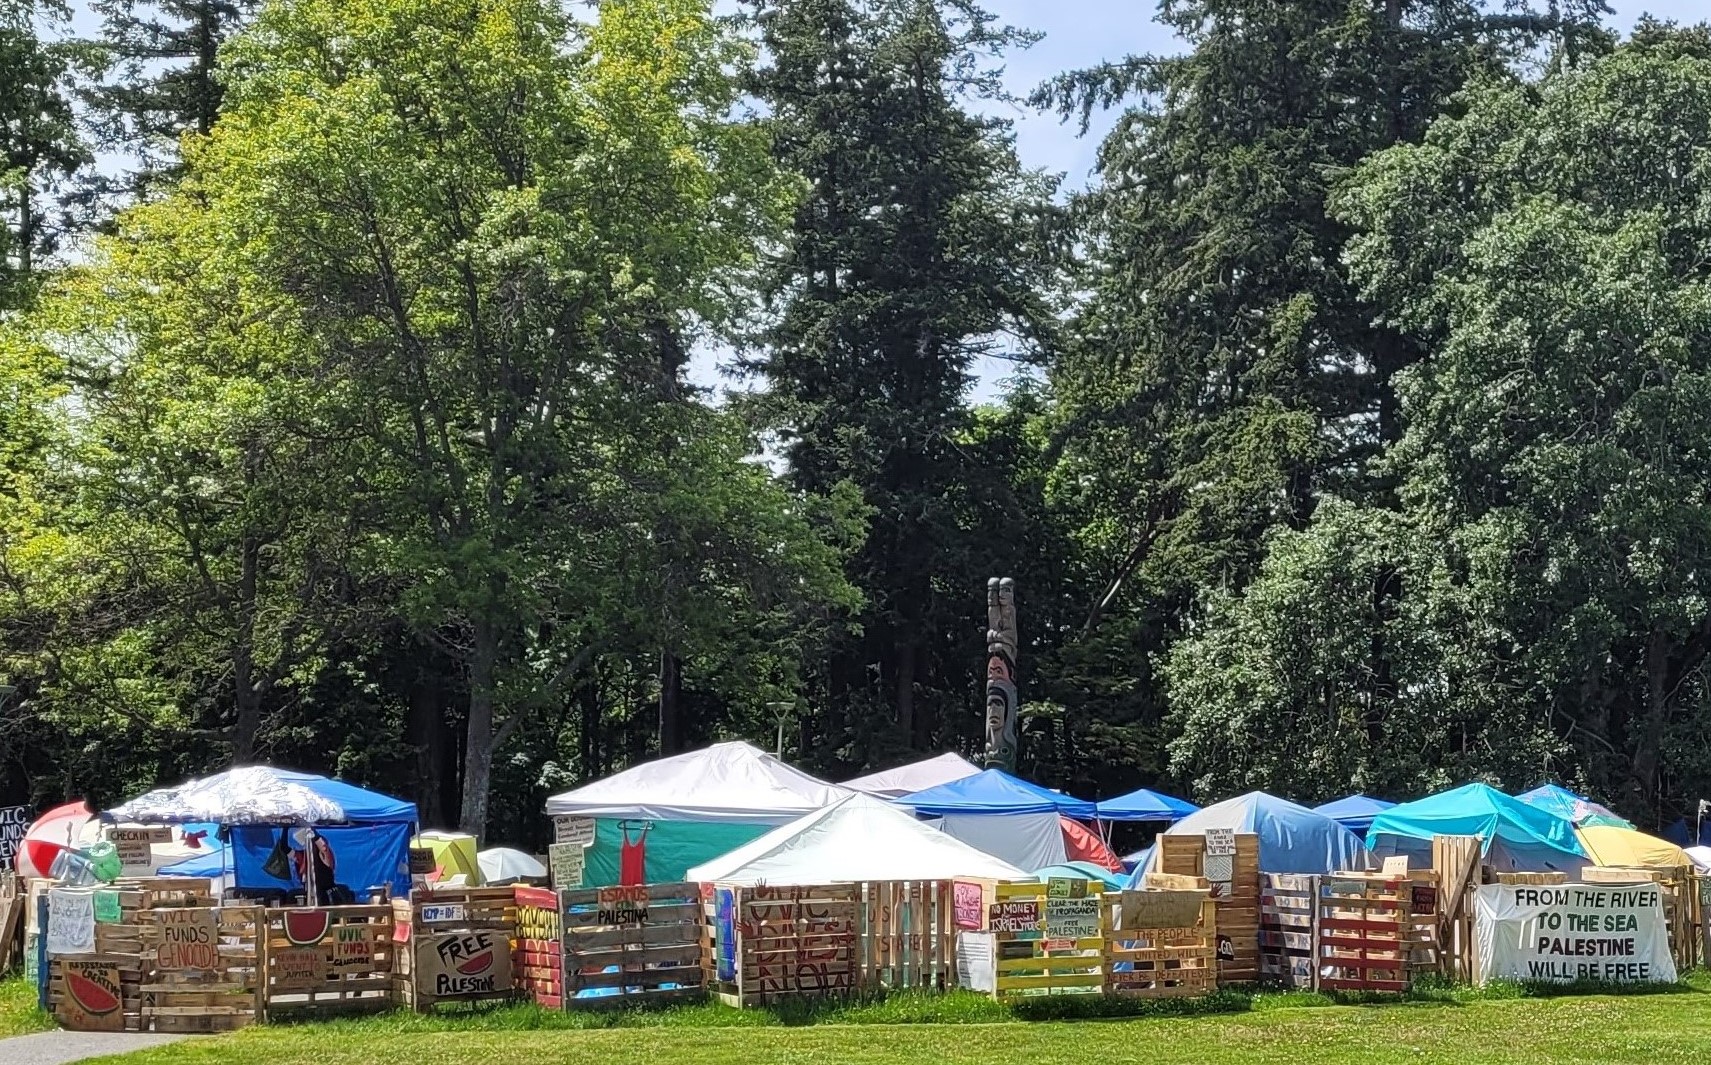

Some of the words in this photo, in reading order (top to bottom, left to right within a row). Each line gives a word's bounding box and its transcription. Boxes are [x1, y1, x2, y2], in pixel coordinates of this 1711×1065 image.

[1514, 888, 1570, 906] FROM
[1574, 890, 1607, 908] THE
[1610, 890, 1658, 909] RIVER
[160, 910, 200, 924] UVIC
[597, 908, 649, 925] PALESTINA
[991, 904, 1001, 915] NO
[1002, 903, 1037, 915] MONEY
[1055, 907, 1096, 916] PROPAGANDA
[1538, 912, 1562, 930] TO
[1567, 913, 1600, 932] THE
[1603, 914, 1638, 932] SEA
[165, 926, 209, 944] FUNDS
[338, 927, 366, 941] UVIC
[1048, 926, 1095, 937] PALESTINE
[1157, 928, 1199, 940] PEOPLE
[436, 932, 494, 967] FREE
[1537, 936, 1635, 956] PALESTINE
[157, 943, 221, 969] GENOCIDE
[1134, 950, 1170, 960] UNITED
[1527, 960, 1574, 979] WILL
[1577, 962, 1600, 979] BE
[1604, 962, 1650, 980] FREE
[436, 973, 496, 995] PALESTINE
